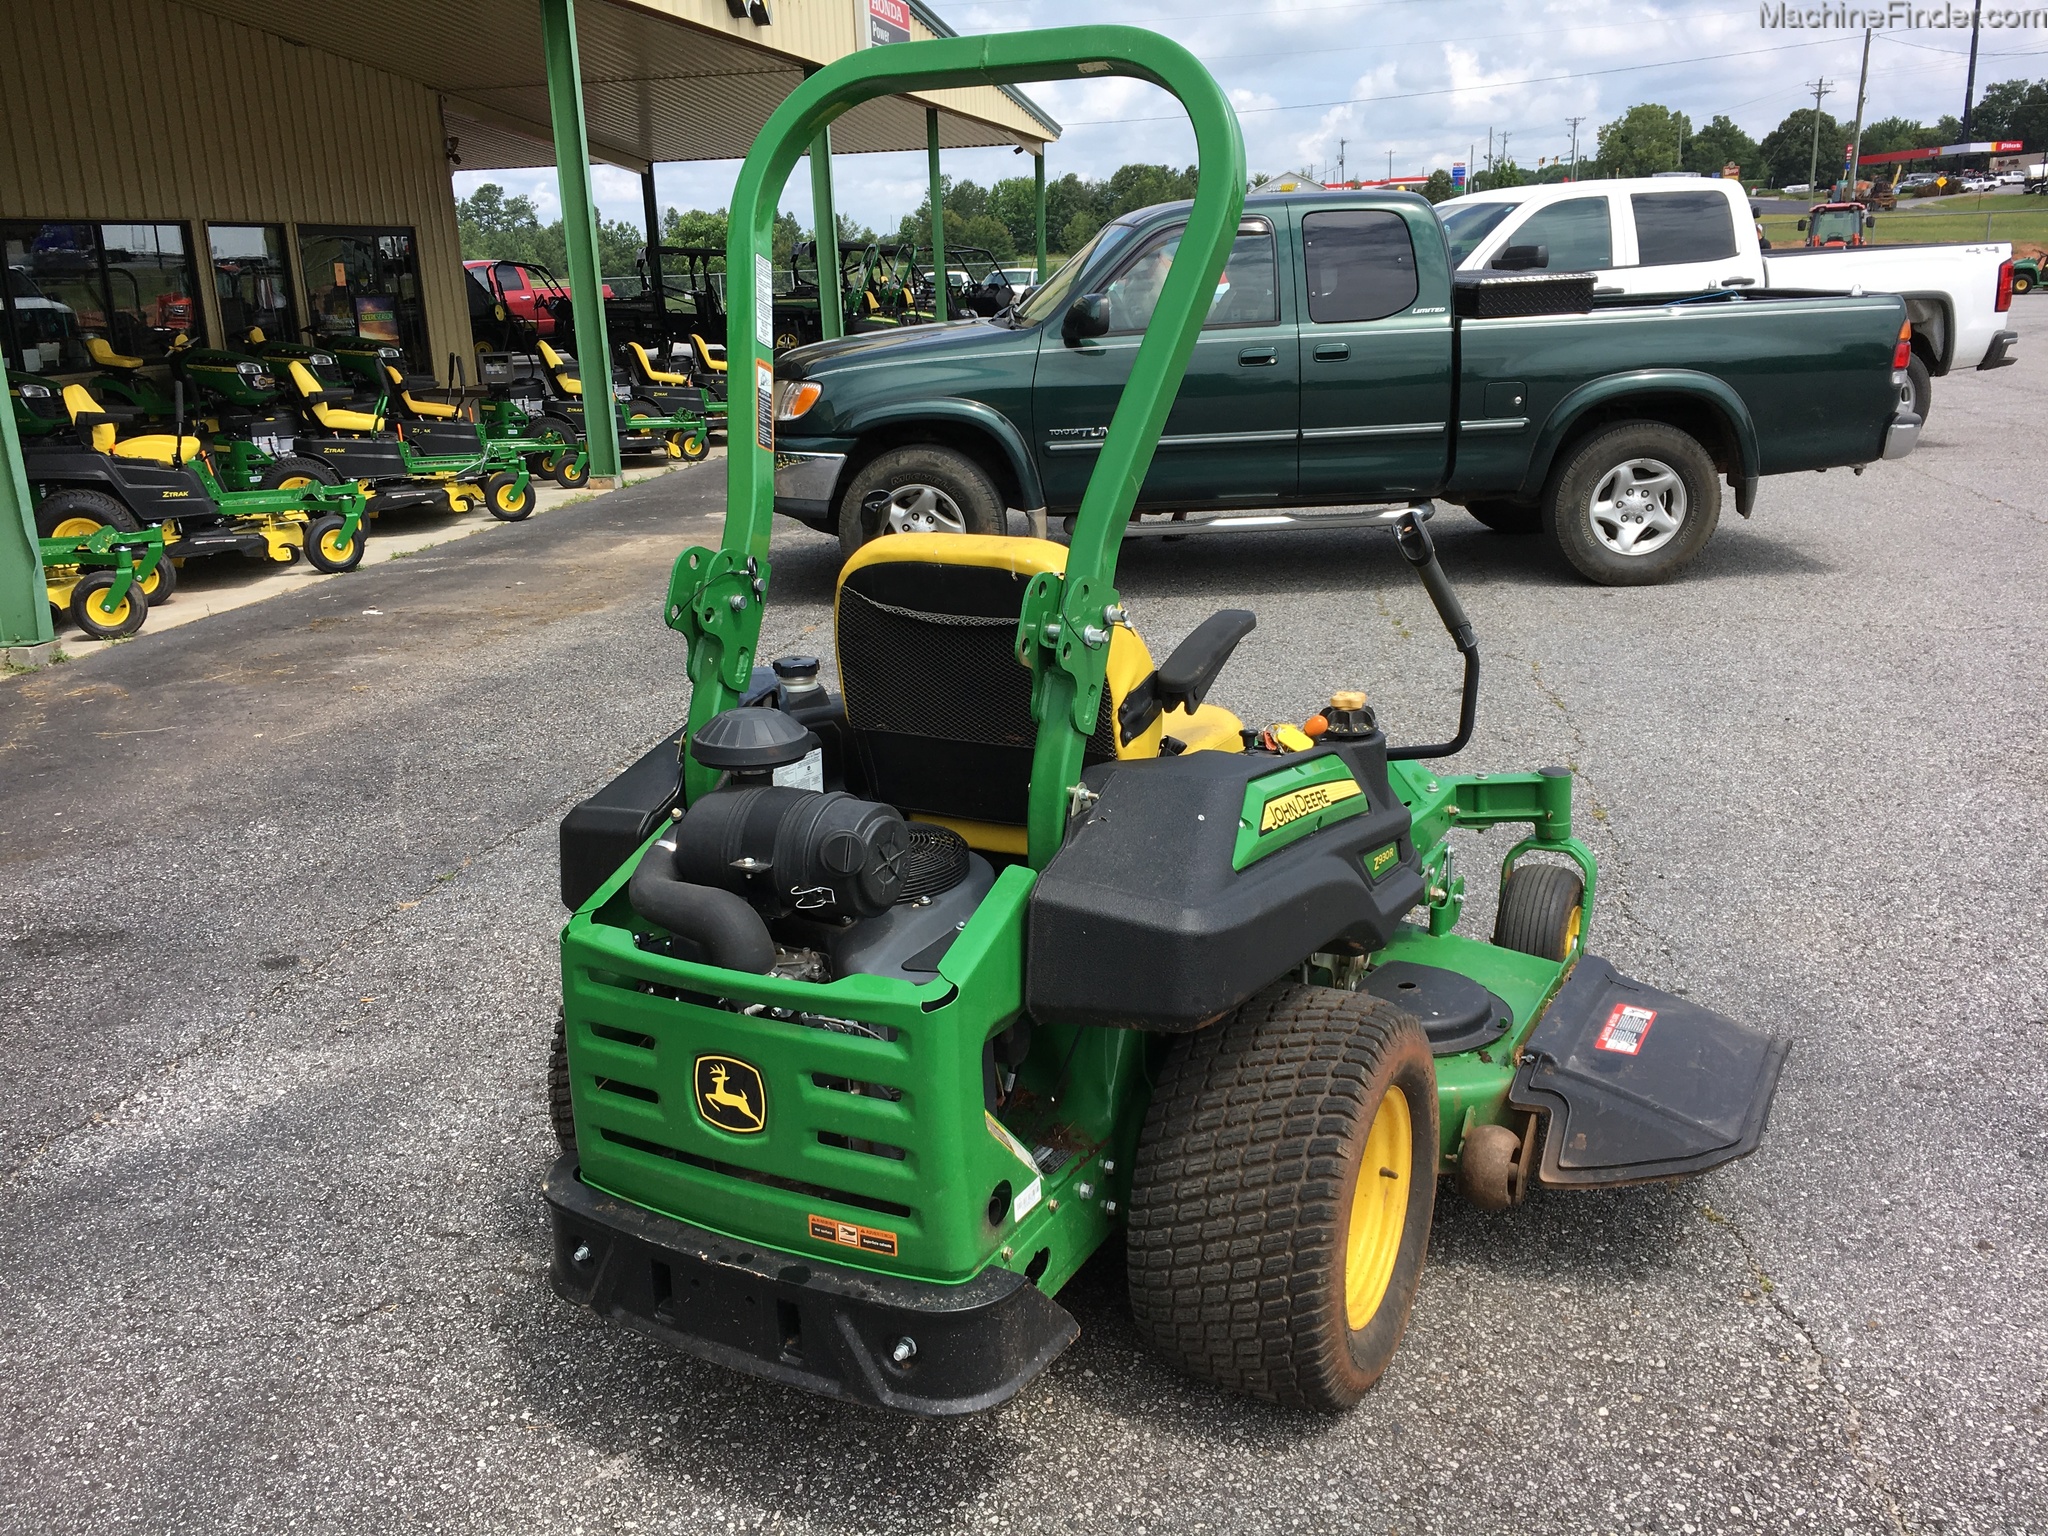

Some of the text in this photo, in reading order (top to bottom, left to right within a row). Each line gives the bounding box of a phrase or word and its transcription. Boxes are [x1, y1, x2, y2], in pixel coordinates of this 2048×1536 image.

[871, 0, 904, 24] HONDA
[872, 20, 890, 43] Power
[1049, 426, 1109, 438] TOYOTA TUN
[162, 490, 189, 498] ZTRAK
[890, 471, 965, 501] MICHELIN
[1269, 789, 1331, 826] JOHN DEERE
[1373, 847, 1394, 871] Z930R
